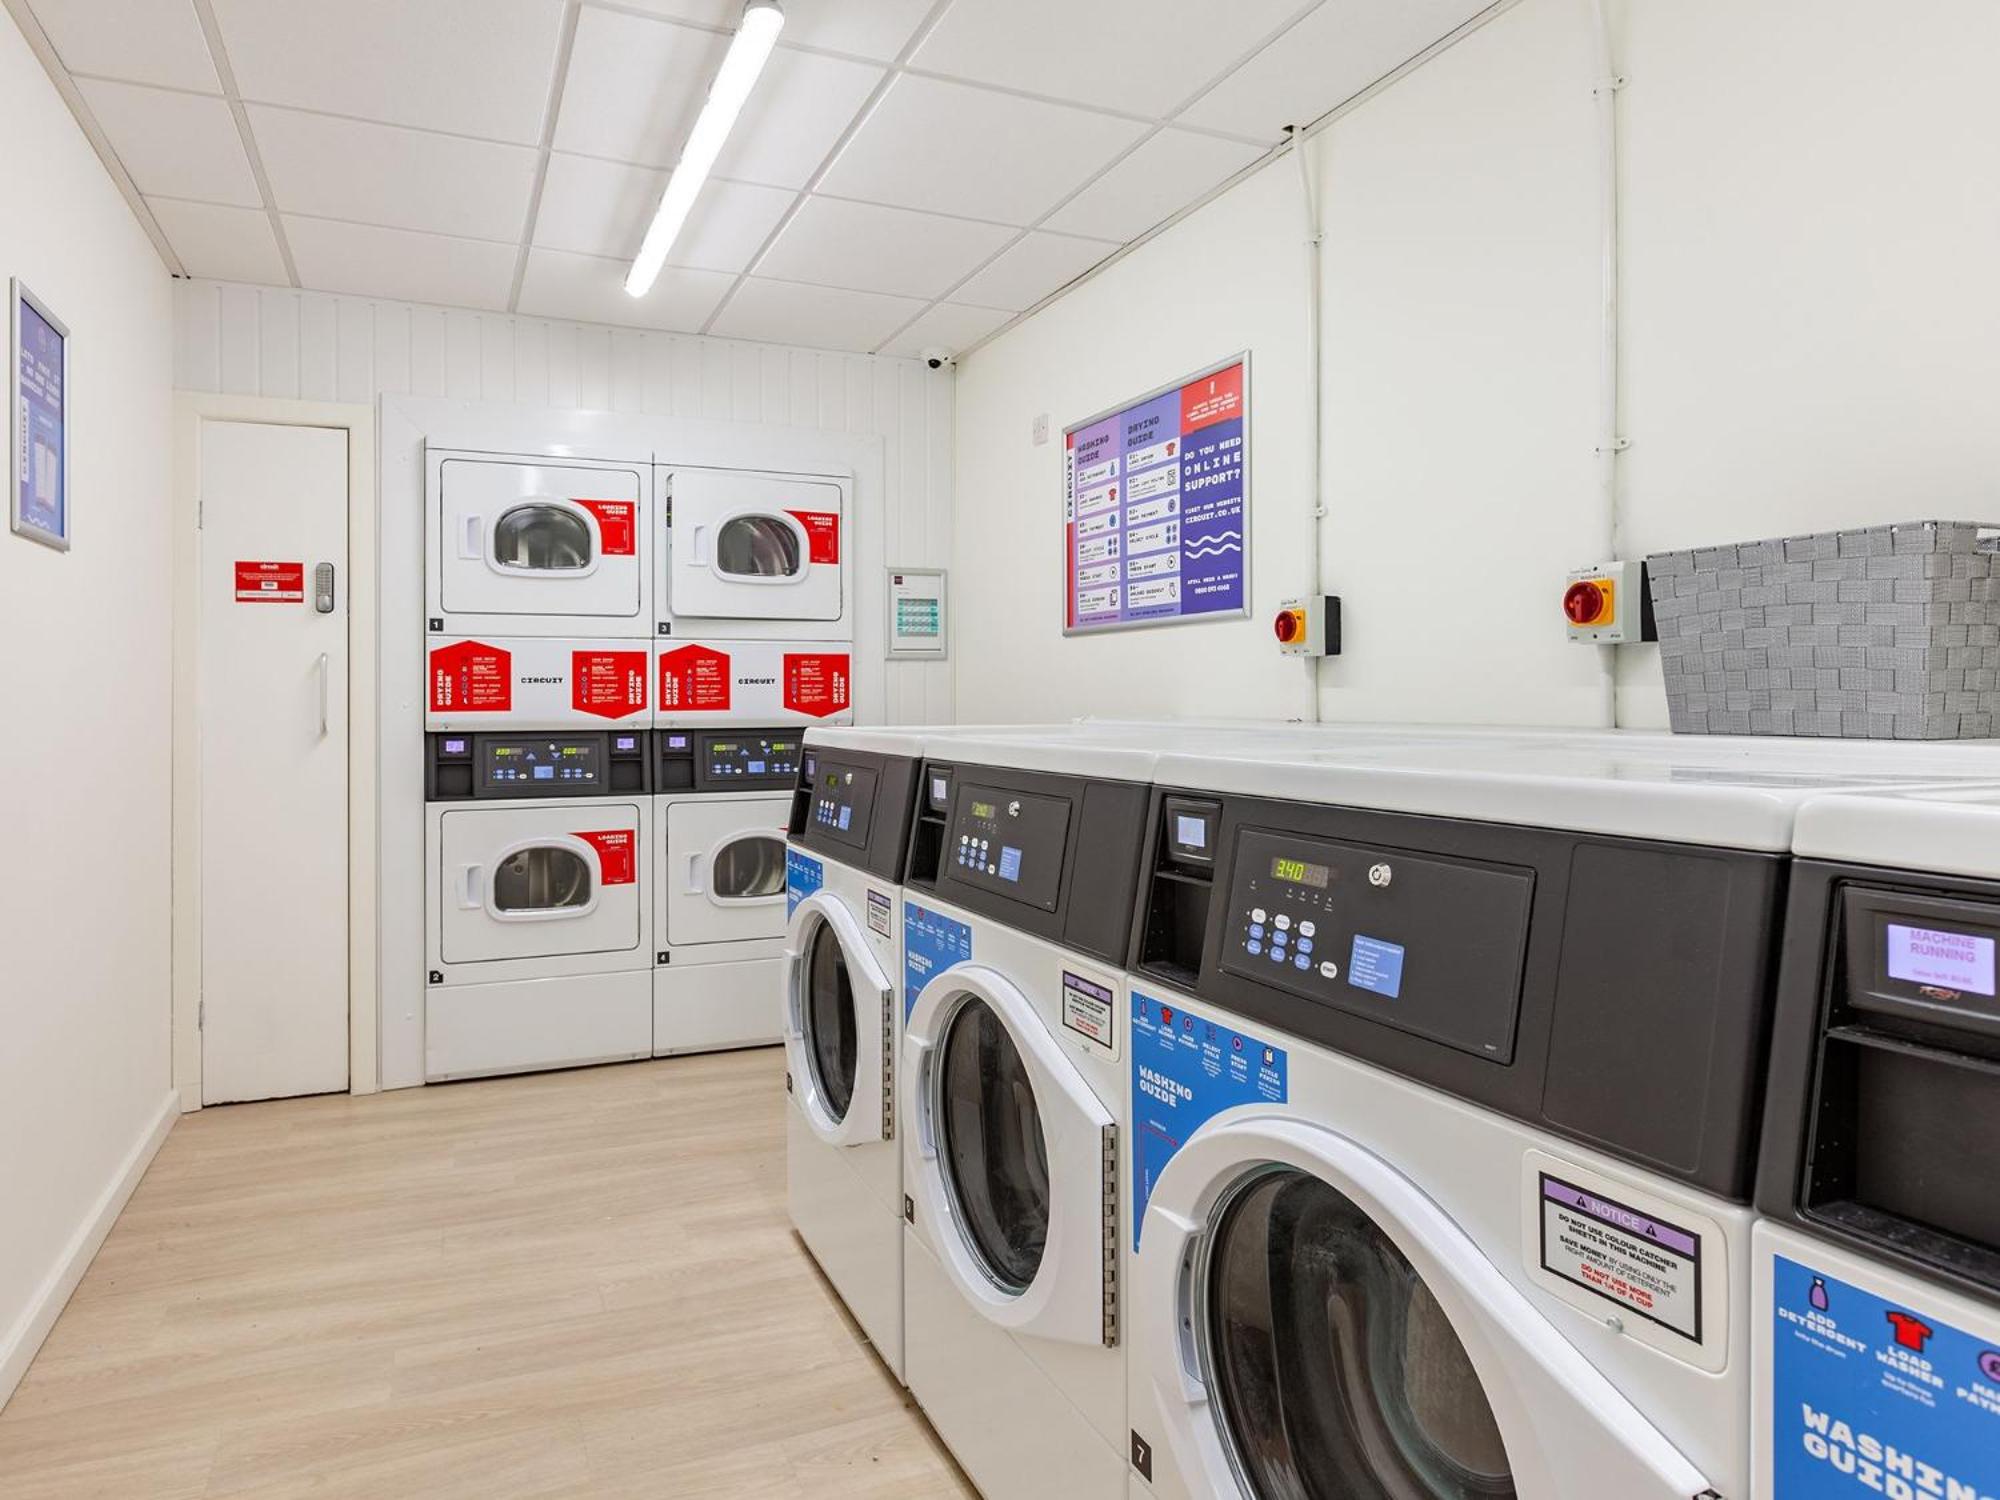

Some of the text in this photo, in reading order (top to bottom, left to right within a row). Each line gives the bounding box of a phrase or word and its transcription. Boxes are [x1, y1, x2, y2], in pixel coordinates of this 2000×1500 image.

[1128, 431, 1153, 447] GUIDE
[1184, 437, 1241, 461] DO YOU NEED
[1184, 451, 1241, 476] ONLINE
[1184, 468, 1241, 492] SUPPORT?
[434, 621, 440, 629] 1
[520, 676, 564, 684] CIRCUIT
[737, 677, 776, 686] CIRCUIT
[1910, 930, 1976, 950] MACHINE
[1910, 942, 1976, 963] RUNNING
[660, 954, 667, 962] 4
[433, 973, 440, 982] 2
[1139, 1064, 1193, 1101] WASHING
[1139, 1079, 1177, 1108] GUIDE
[1591, 1200, 1640, 1230] NOTICE
[1558, 1213, 1678, 1270] DO NOT USE COLOUR CATCHER
[1568, 1225, 1667, 1274] SHEETS IN THIS MACHINE
[1560, 1235, 1579, 1248] SAVE
[1580, 1243, 1608, 1260] MONEY
[1619, 1260, 1641, 1277] USING
[1642, 1270, 1662, 1284] ONLY
[1662, 1281, 1677, 1293] THE
[1565, 1245, 1671, 1297] RIGHT AMOUNT OF DETERGENT
[1580, 1263, 1653, 1300] DO NOT USE MORE
[1581, 1271, 1602, 1285] THAN
[1604, 1281, 1615, 1291] 1/4
[1616, 1287, 1627, 1297] OF
[1636, 1297, 1653, 1309] CUP
[1778, 1307, 1867, 1353] DETERGENT
[1806, 1310, 1837, 1330] ADD
[1875, 1350, 1944, 1389] WASHER
[1887, 1345, 1933, 1372] LOAD
[1136, 1444, 1145, 1464] 7
[1802, 1403, 2000, 1500] WASHIN
